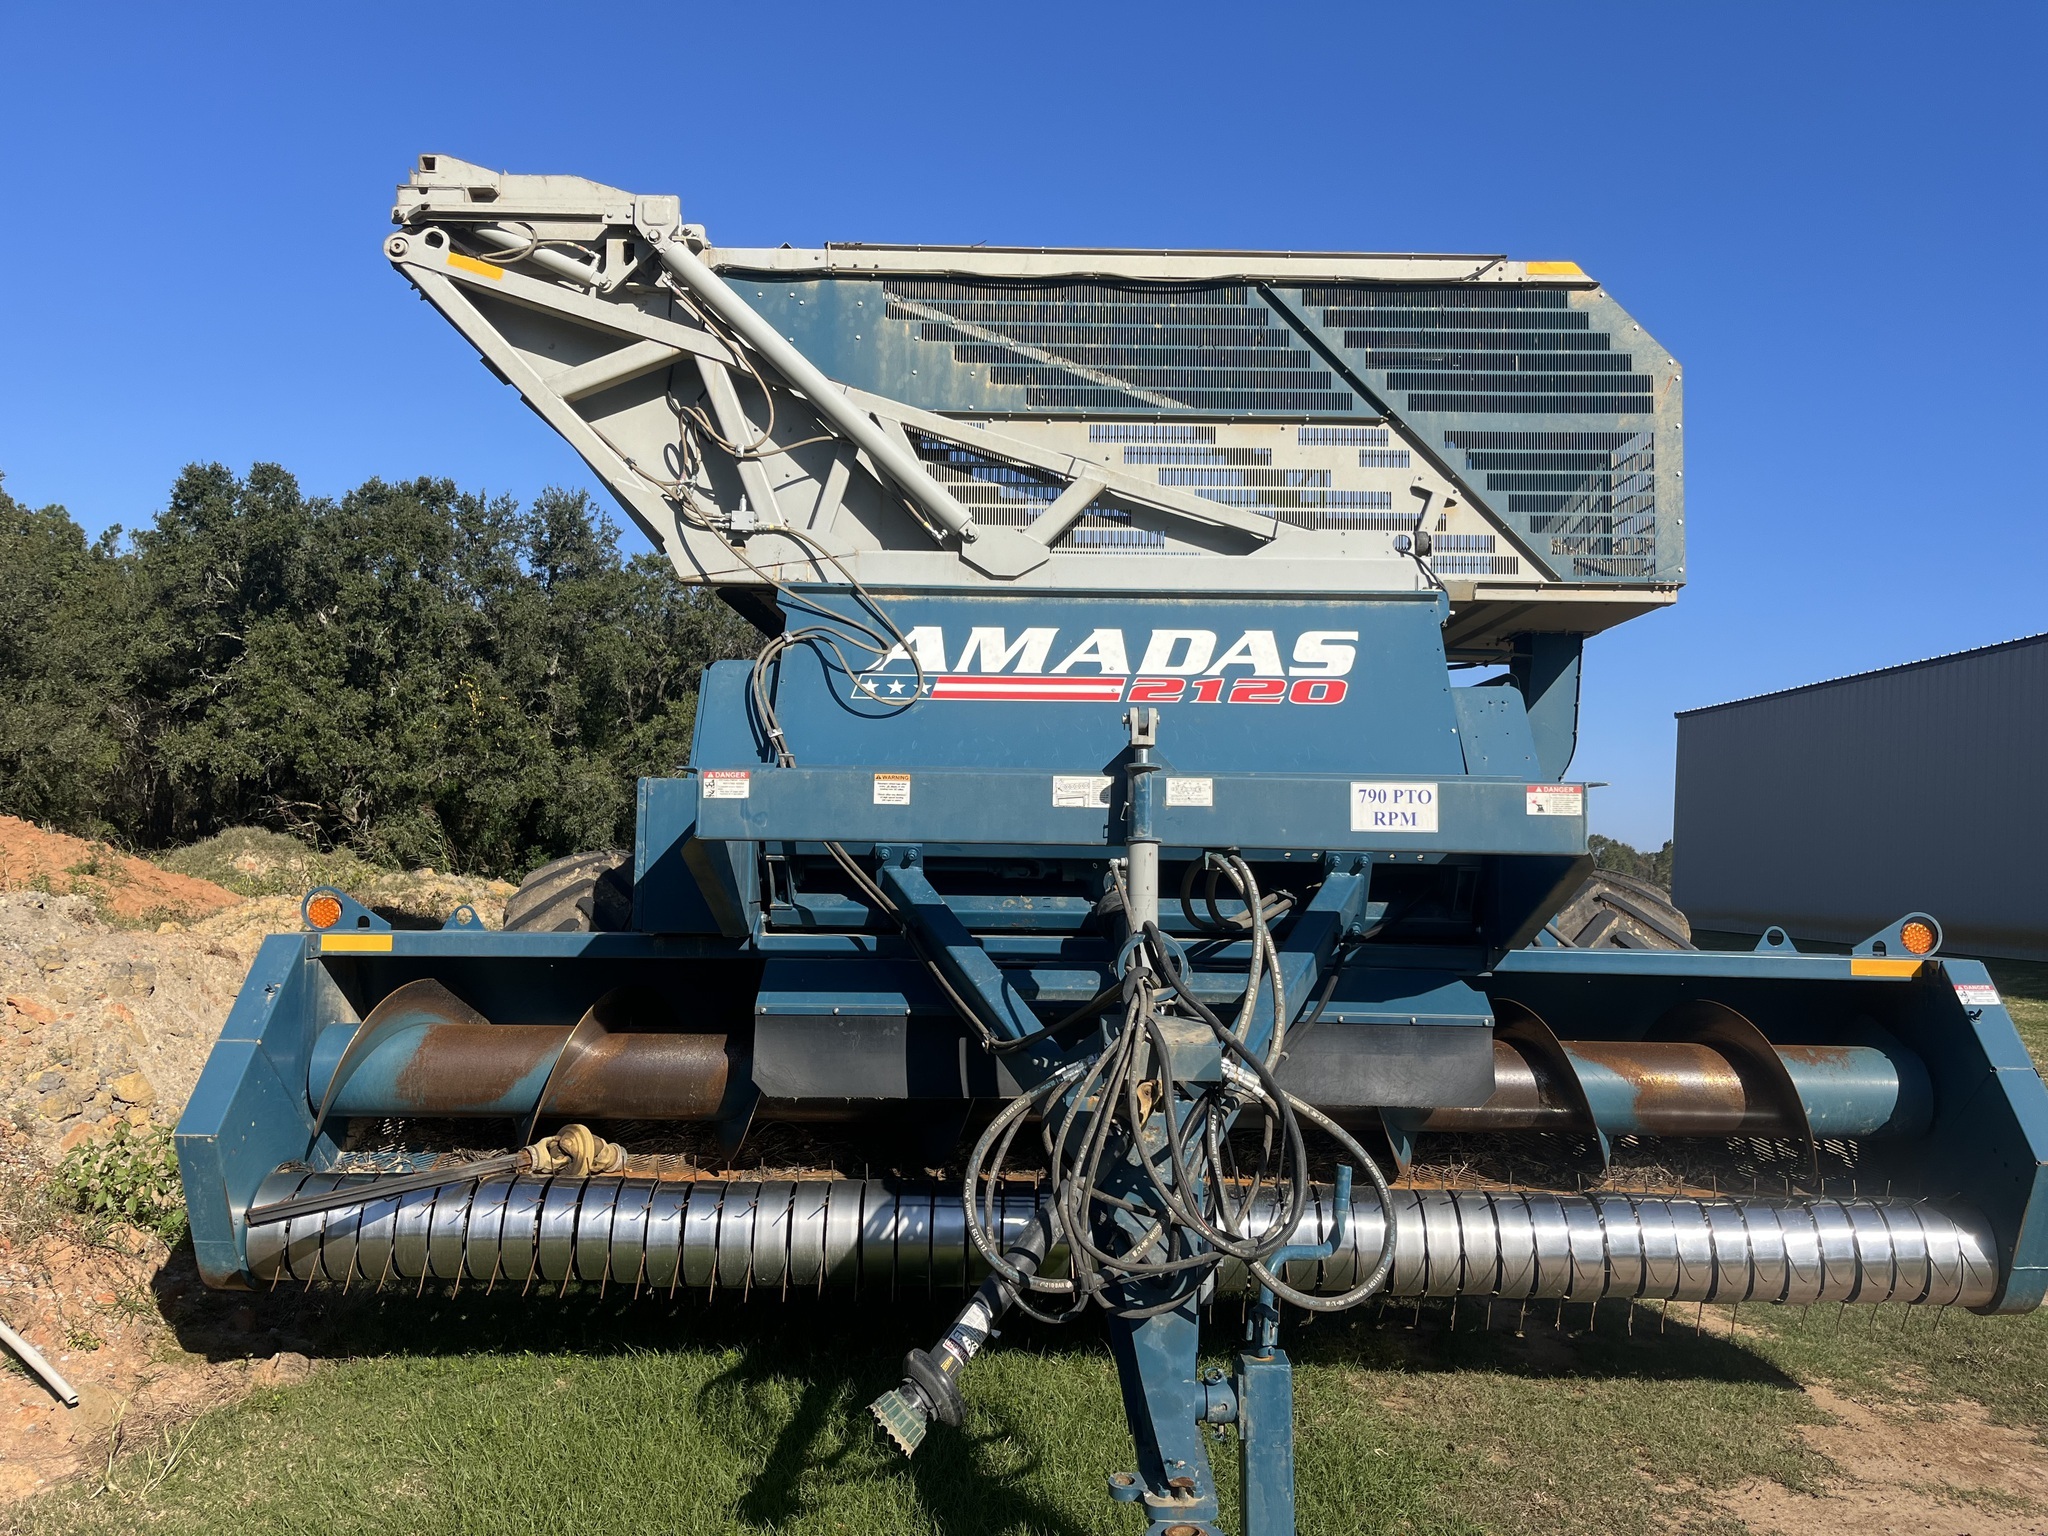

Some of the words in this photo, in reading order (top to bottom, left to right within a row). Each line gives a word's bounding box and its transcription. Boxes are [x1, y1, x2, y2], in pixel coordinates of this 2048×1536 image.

[871, 626, 1359, 677] AMADAS
[1124, 676, 1349, 705] 2120
[715, 771, 746, 779] DANGER
[1358, 788, 1387, 804] 790
[1393, 788, 1432, 805] PTO
[1373, 811, 1417, 827] RPM
